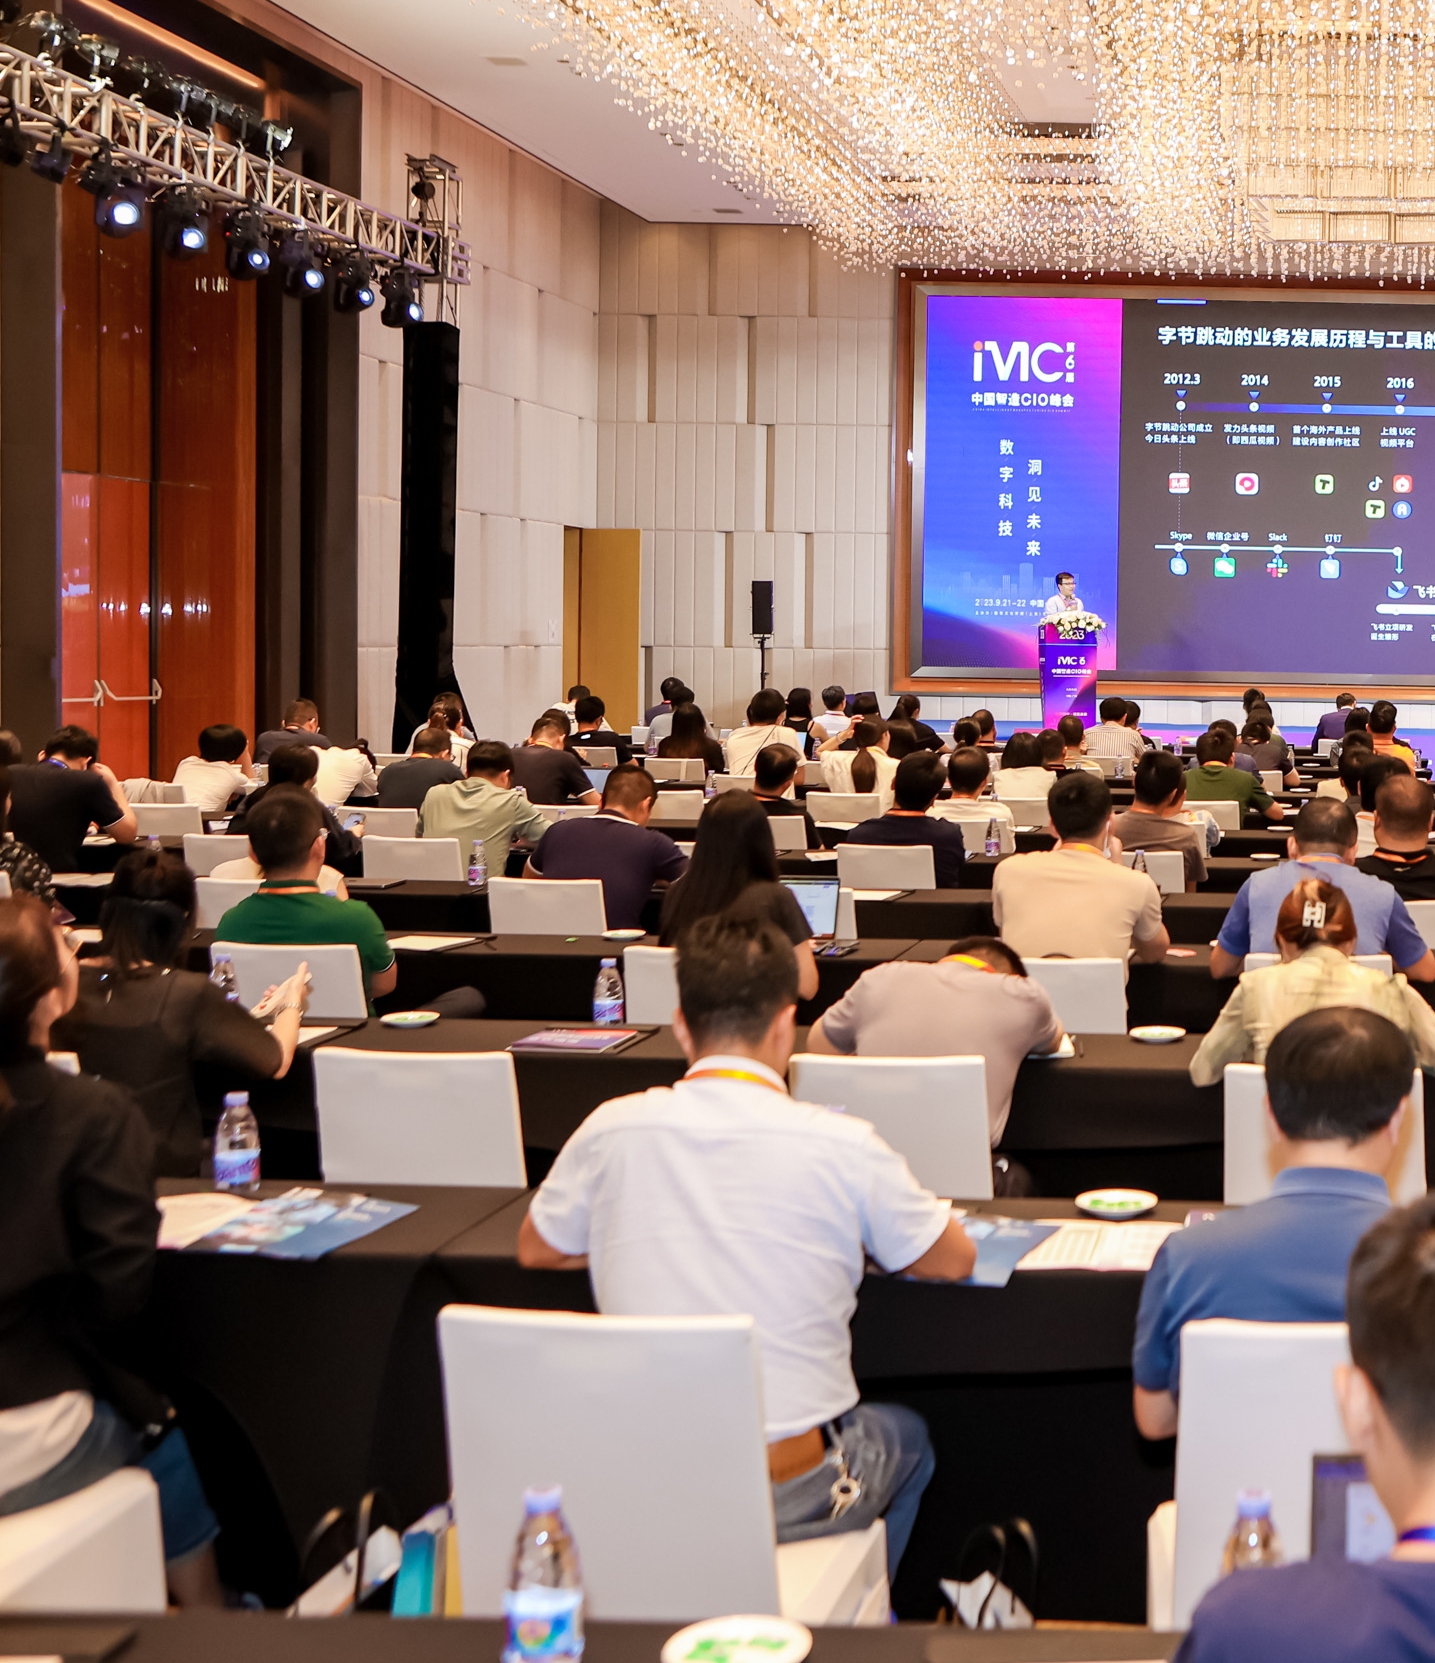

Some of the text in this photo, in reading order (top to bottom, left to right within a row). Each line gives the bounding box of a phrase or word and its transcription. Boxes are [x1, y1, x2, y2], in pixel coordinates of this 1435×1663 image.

[1163, 373, 1201, 385] 2012.3
[1241, 374, 1269, 386] 2014
[1313, 376, 1341, 388] 2015
[1386, 377, 1415, 389] 2016
[971, 392, 1074, 408] 中国智造CIO峰会
[1145, 422, 1213, 433] 字节跳动公司成立
[1223, 423, 1275, 433] 发力头条视频
[1292, 425, 1361, 435] 首个海外产品上线
[1380, 426, 1416, 436] 上线 UGC
[1145, 434, 1196, 444] 今日头条上线
[1292, 436, 1360, 447] 建设内容创作社区
[1380, 438, 1414, 448] 视频平台
[998, 439, 1014, 537] 数字科技
[1026, 459, 1042, 557] 洞见未来
[1169, 531, 1193, 541] Skype
[1206, 531, 1250, 542] 微信企业号
[1268, 532, 1288, 542] Slack
[1324, 533, 1342, 543] 钉钉
[974, 598, 1026, 607] 223.9.21-22
